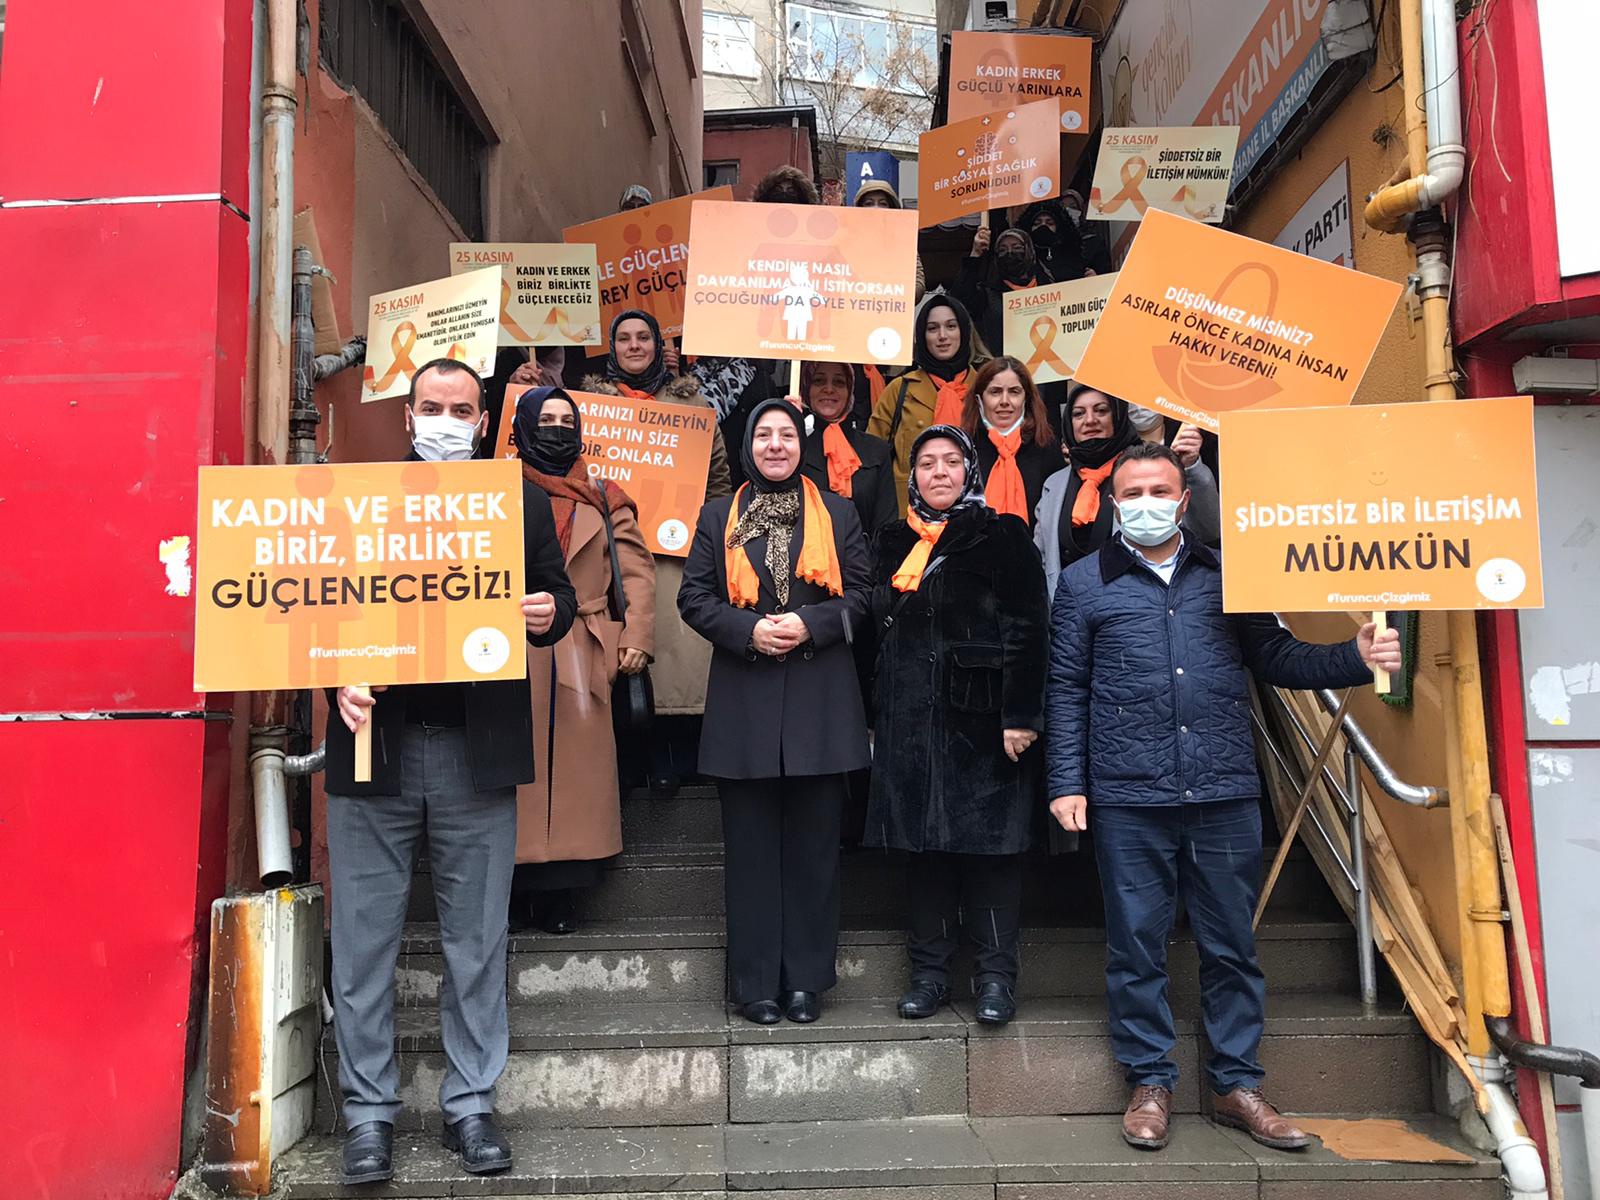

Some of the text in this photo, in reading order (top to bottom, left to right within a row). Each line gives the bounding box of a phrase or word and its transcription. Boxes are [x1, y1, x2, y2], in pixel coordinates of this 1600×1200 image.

[976, 65, 1061, 80] KADIN ERKEK
[957, 78, 1083, 98] GÜÇLÜ YARINLARA
[1106, 134, 1159, 145] 25 KASIM
[1158, 147, 1204, 163] ŞİDDETSİZ
[1206, 148, 1221, 161] BİR
[934, 157, 1037, 191] BİR SOSYAL SAĞLIK
[1147, 165, 1230, 181] İLETİŞİM MÜMKÜN!
[1305, 194, 1347, 255] PARTİ
[456, 251, 514, 263] 25 KASIM
[516, 266, 545, 276] KADIN
[547, 266, 559, 276] VE
[561, 266, 590, 276] ERKEK
[747, 258, 852, 276] KENDİNE NASIL
[517, 278, 591, 290] BİRİZ BİRLİKTE
[824, 277, 905, 296] İSTİYORSAN
[373, 301, 387, 315] 25
[389, 292, 424, 311] KASIM
[464, 298, 488, 310] ÜZMEYİN
[518, 292, 592, 306] GÜÇLENECEĞİZ
[694, 290, 906, 314] ÇOCUĞUNU DA ÖYLE YETİŞTİR!
[1008, 299, 1021, 310] 25
[1024, 291, 1061, 307] KASIM
[430, 310, 482, 327] ONLAR ALLAHIN SİZE
[1060, 302, 1086, 317] KADIN
[1164, 286, 1314, 347] DÜŞÜNMEZ MİSİNİZ?
[448, 324, 469, 334] ONLARA
[1062, 318, 1095, 334] TOPLUM
[433, 337, 447, 346] OLUN
[1121, 293, 1348, 382] ASIRLAR ÖNCE KADINA İNSAN
[1169, 331, 1277, 379] HAKKI VERENİ!
[638, 407, 711, 433] ÜZMEYİN,
[648, 429, 679, 448] SİZE
[587, 463, 632, 482] OLUN
[211, 492, 508, 527] KADIN VE ERKEK
[1235, 493, 1522, 533] ŞİDDETSİZ BİR İLETİŞİM
[255, 526, 492, 567] BİRİZ, BİRLİKTE
[1284, 531, 1471, 572] MÜMKÜN
[211, 565, 512, 614] GÜÇLENECEĞİZ!
